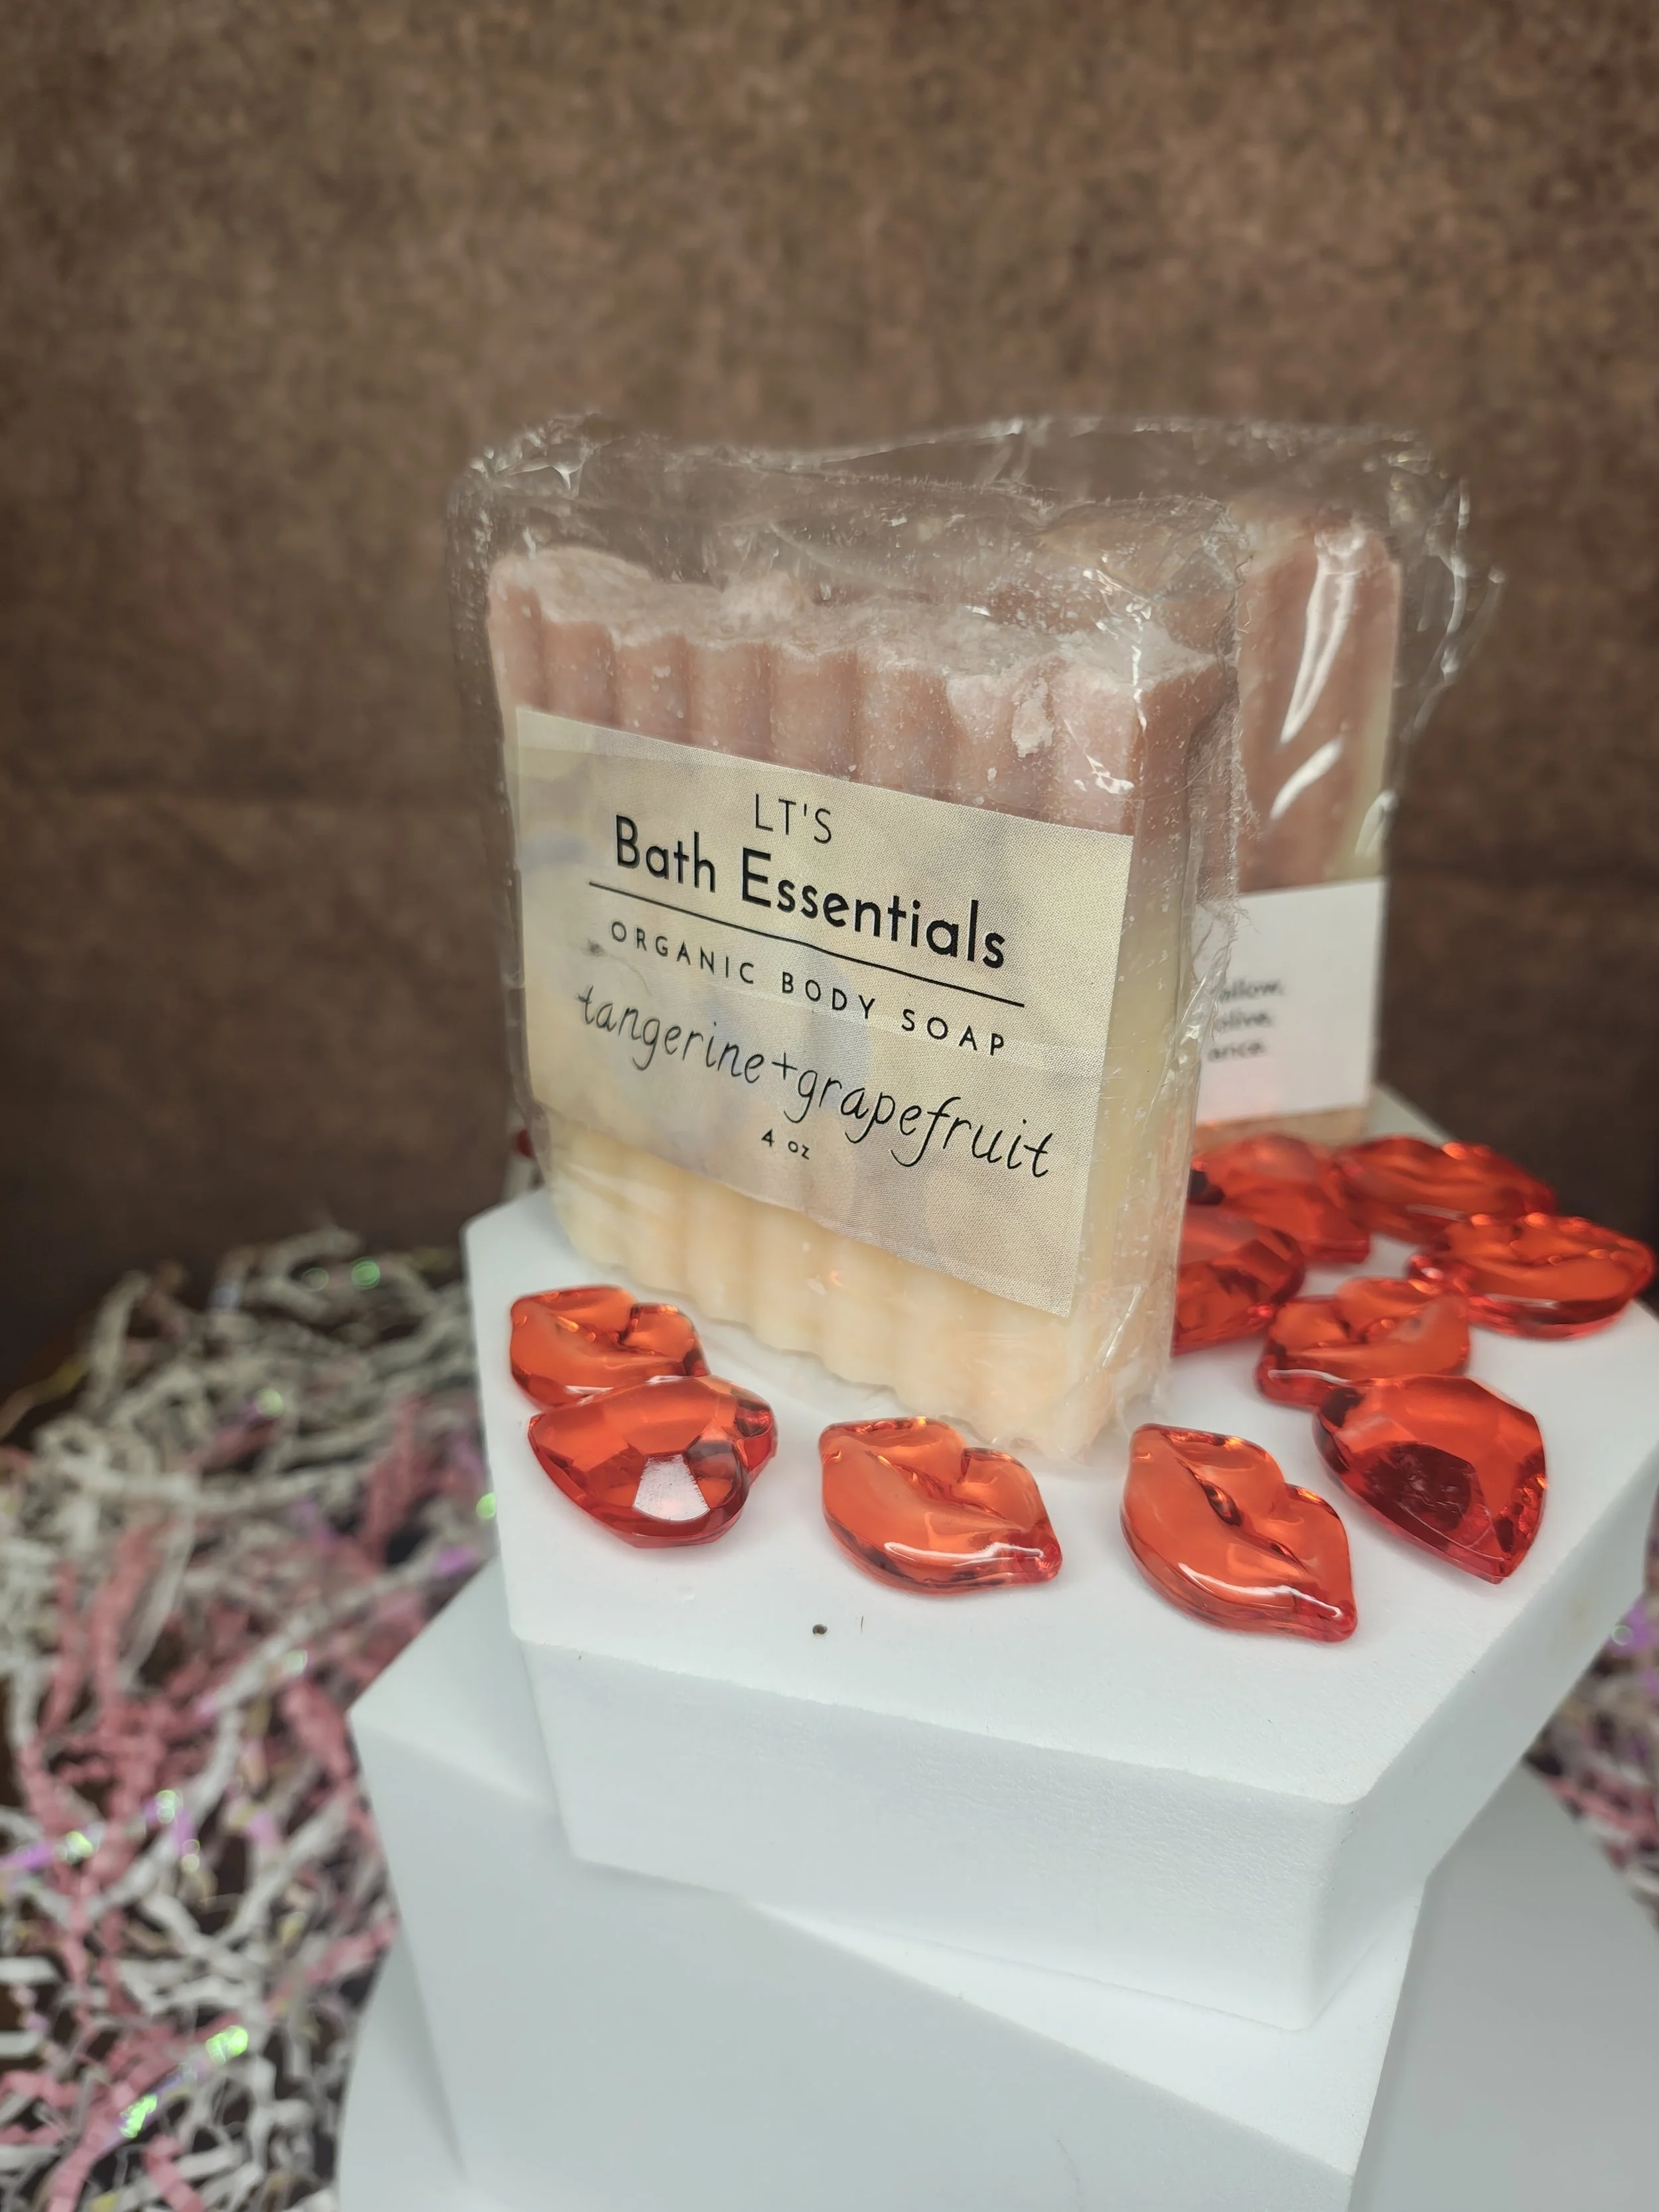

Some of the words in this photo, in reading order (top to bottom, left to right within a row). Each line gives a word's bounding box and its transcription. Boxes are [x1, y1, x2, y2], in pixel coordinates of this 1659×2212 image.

[755, 792, 833, 846] LT'S
[615, 814, 717, 894] Bath
[741, 846, 1007, 970] Essentials
[610, 921, 755, 986] ORGANIC
[781, 970, 877, 1020] BODY
[900, 1007, 1006, 1057] SOAP
[576, 985, 1056, 1179] tangerine+grapefruit
[760, 1128, 775, 1148] 4
[787, 1140, 811, 1161] oz
